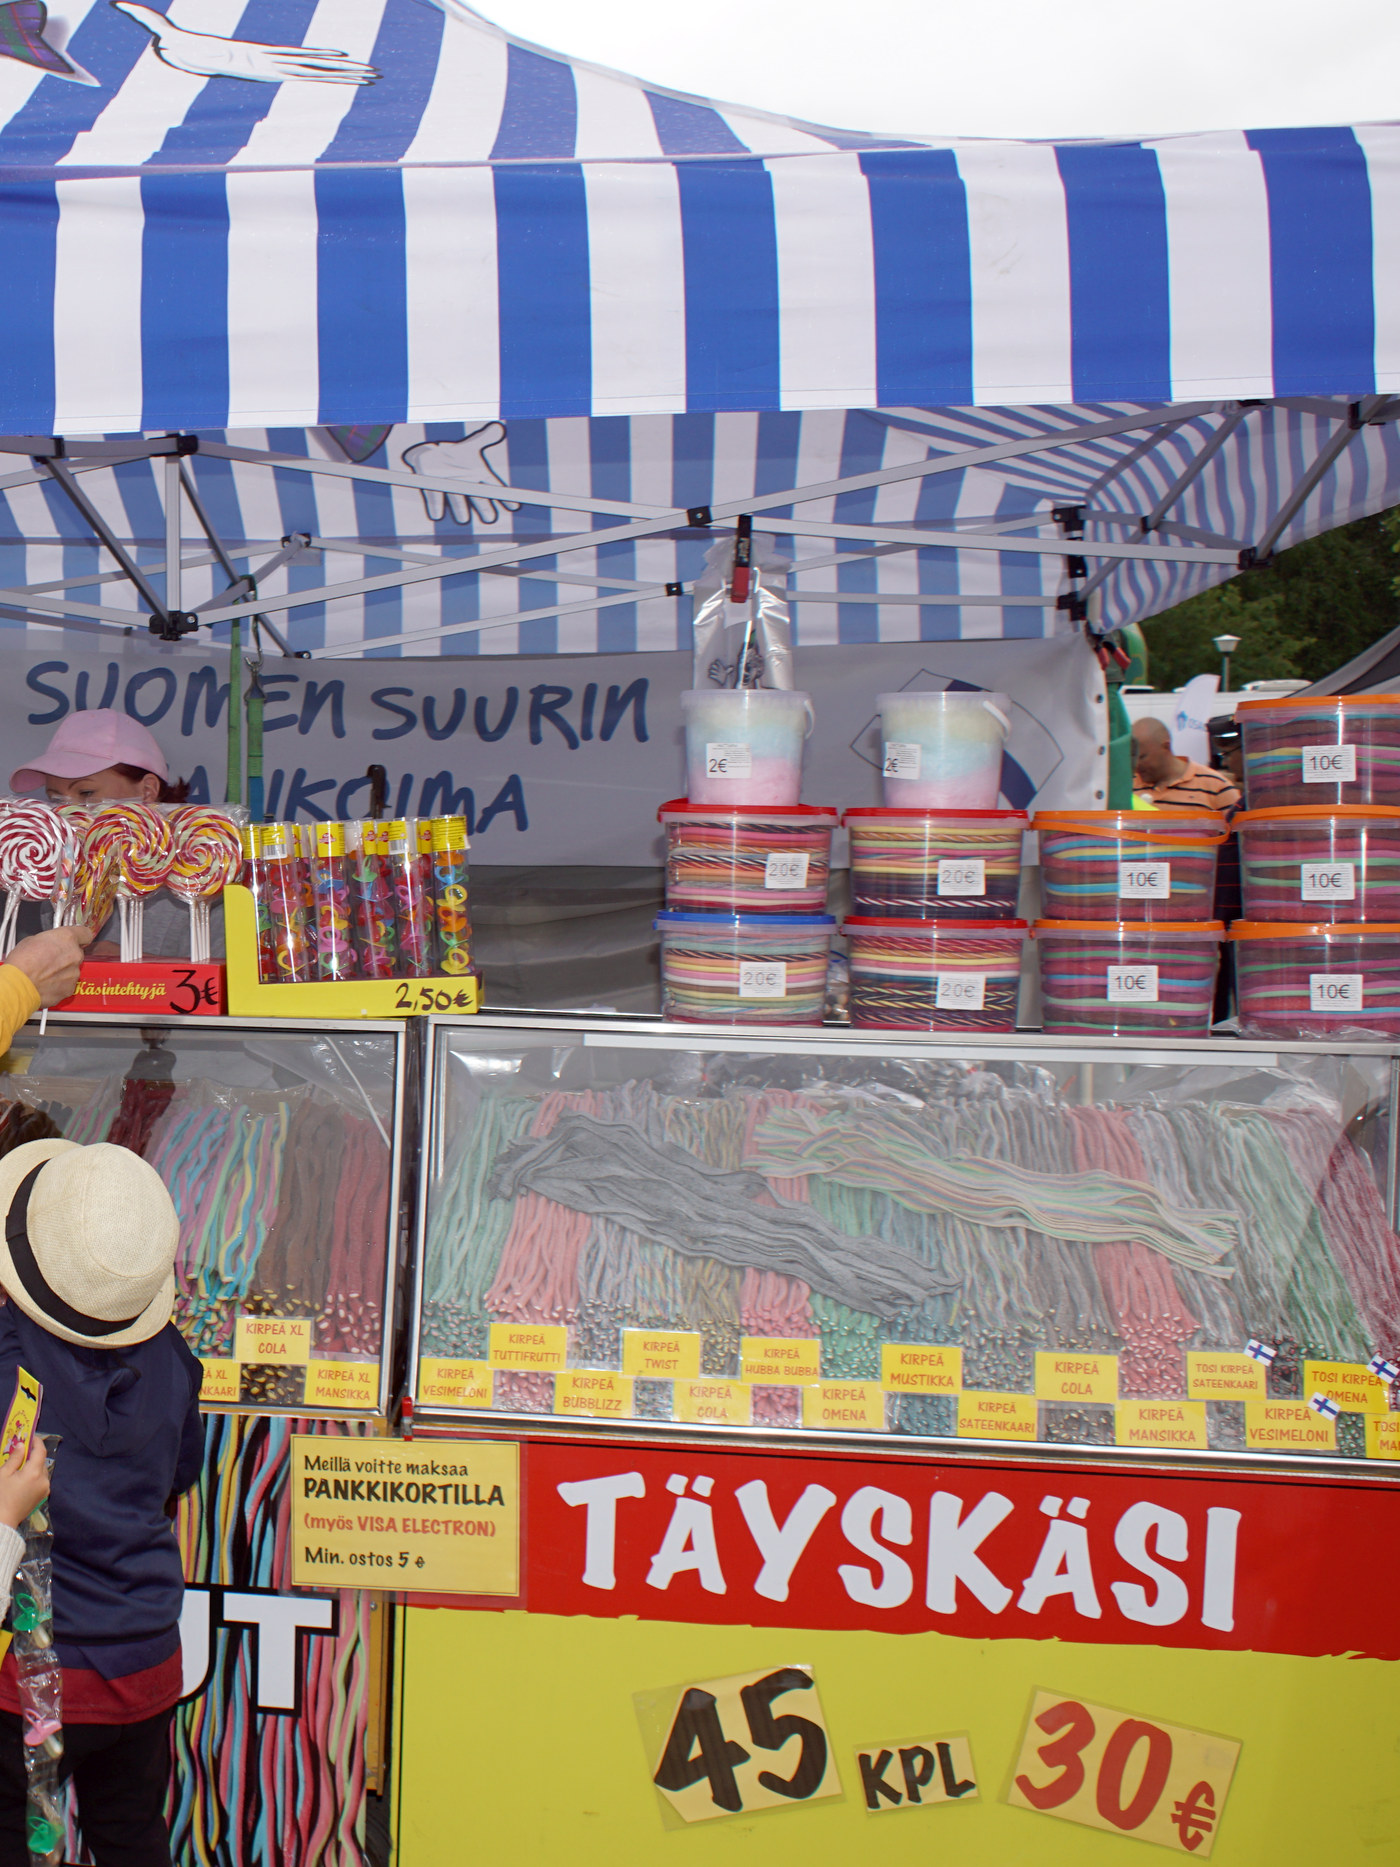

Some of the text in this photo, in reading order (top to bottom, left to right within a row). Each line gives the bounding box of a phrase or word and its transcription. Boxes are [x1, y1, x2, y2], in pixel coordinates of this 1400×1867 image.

[26, 661, 650, 750] SUOMEN SUURIN
[708, 758, 728, 773] 2€
[885, 758, 899, 773] 2€
[1309, 756, 1343, 771] 10€
[768, 863, 800, 878] 20€
[942, 870, 975, 885] 20€
[1126, 872, 1159, 887] 10€
[1308, 873, 1342, 888] 10€
[743, 972, 777, 986] 20€
[1114, 975, 1146, 990] 10€
[74, 981, 166, 1000] Käsintehtyjä
[942, 983, 975, 998] 20€
[1316, 984, 1350, 998] 10€
[246, 1322, 305, 1336] KIRPEÄ XL
[509, 1333, 546, 1346] KIRPEÄ
[643, 1340, 680, 1353] KIRPEÄ
[258, 1342, 287, 1355] COLA
[763, 1347, 800, 1360] KIRPEÄ
[493, 1350, 561, 1364] TUTTIFRUTTI
[644, 1358, 678, 1371] TWIST
[900, 1352, 944, 1367] KIRPEÄ
[437, 1367, 474, 1380] KIRPEÄ
[745, 1364, 819, 1377] HUBBA BUBBA
[1054, 1361, 1099, 1375] KIRPEÄ
[1196, 1362, 1254, 1375] TOSI KIRPEÄ
[317, 1368, 371, 1384] KIRPEÄ XL
[572, 1376, 614, 1391] KIRPEÄ
[890, 1373, 954, 1388] MUSTIKKA
[1312, 1370, 1338, 1384] TOSI
[1061, 1382, 1093, 1396] COLA
[1193, 1378, 1259, 1390] SATEENKAARI
[315, 1386, 371, 1401] MANSIKKA
[423, 1385, 487, 1399] VESIMELONI
[689, 1386, 732, 1399] KIRPEÄ
[822, 1387, 866, 1401] KIRPEÄ
[1326, 1390, 1369, 1404] OMENA
[563, 1397, 622, 1411] BUBBLIZZ
[977, 1401, 1017, 1414] KIRPEÄ
[697, 1406, 728, 1419] COLA
[822, 1408, 867, 1421] OMENA
[1138, 1406, 1184, 1422] KIRPEÄ
[1265, 1406, 1311, 1422] KIRPEÄ
[959, 1419, 1036, 1434] SATEENKAARI
[1129, 1429, 1196, 1443] MANSIKKA
[1250, 1428, 1329, 1443] VESIMELONI
[304, 1455, 468, 1476] Meillä voitte maksaa
[304, 1477, 505, 1506] PANKKIKORTILLA
[304, 1512, 496, 1537] (myös VISA ELECTRON)
[304, 1547, 344, 1565] Min.
[349, 1551, 393, 1567] ostos
[398, 1551, 410, 1568] 5
[557, 1472, 1243, 1632] TÄYSKÄSI
[654, 1668, 828, 1814] 45
[858, 1742, 976, 1810] KPL
